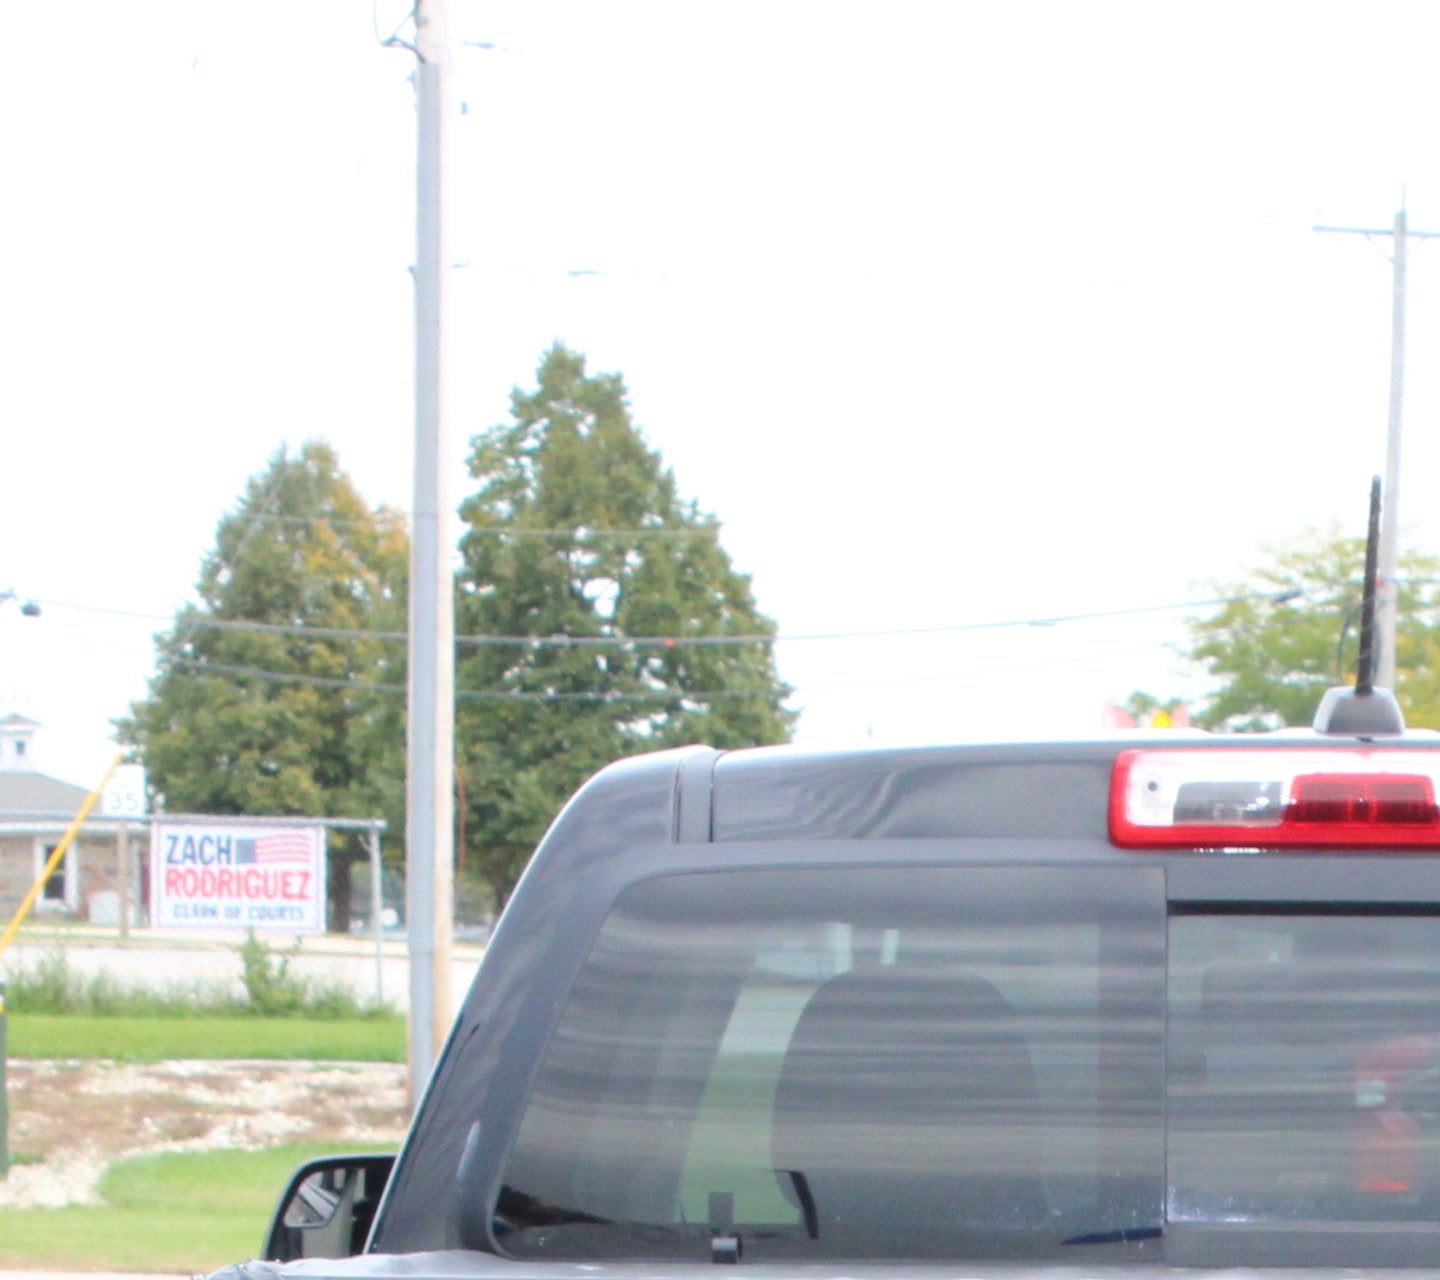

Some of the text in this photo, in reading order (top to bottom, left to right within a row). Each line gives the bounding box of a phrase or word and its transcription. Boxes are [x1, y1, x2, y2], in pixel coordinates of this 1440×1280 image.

[110, 793, 139, 812] 35
[165, 834, 232, 865] ZACH
[164, 868, 311, 900] RODRIGUEZ
[173, 904, 305, 921] CLERK OF COURTS
